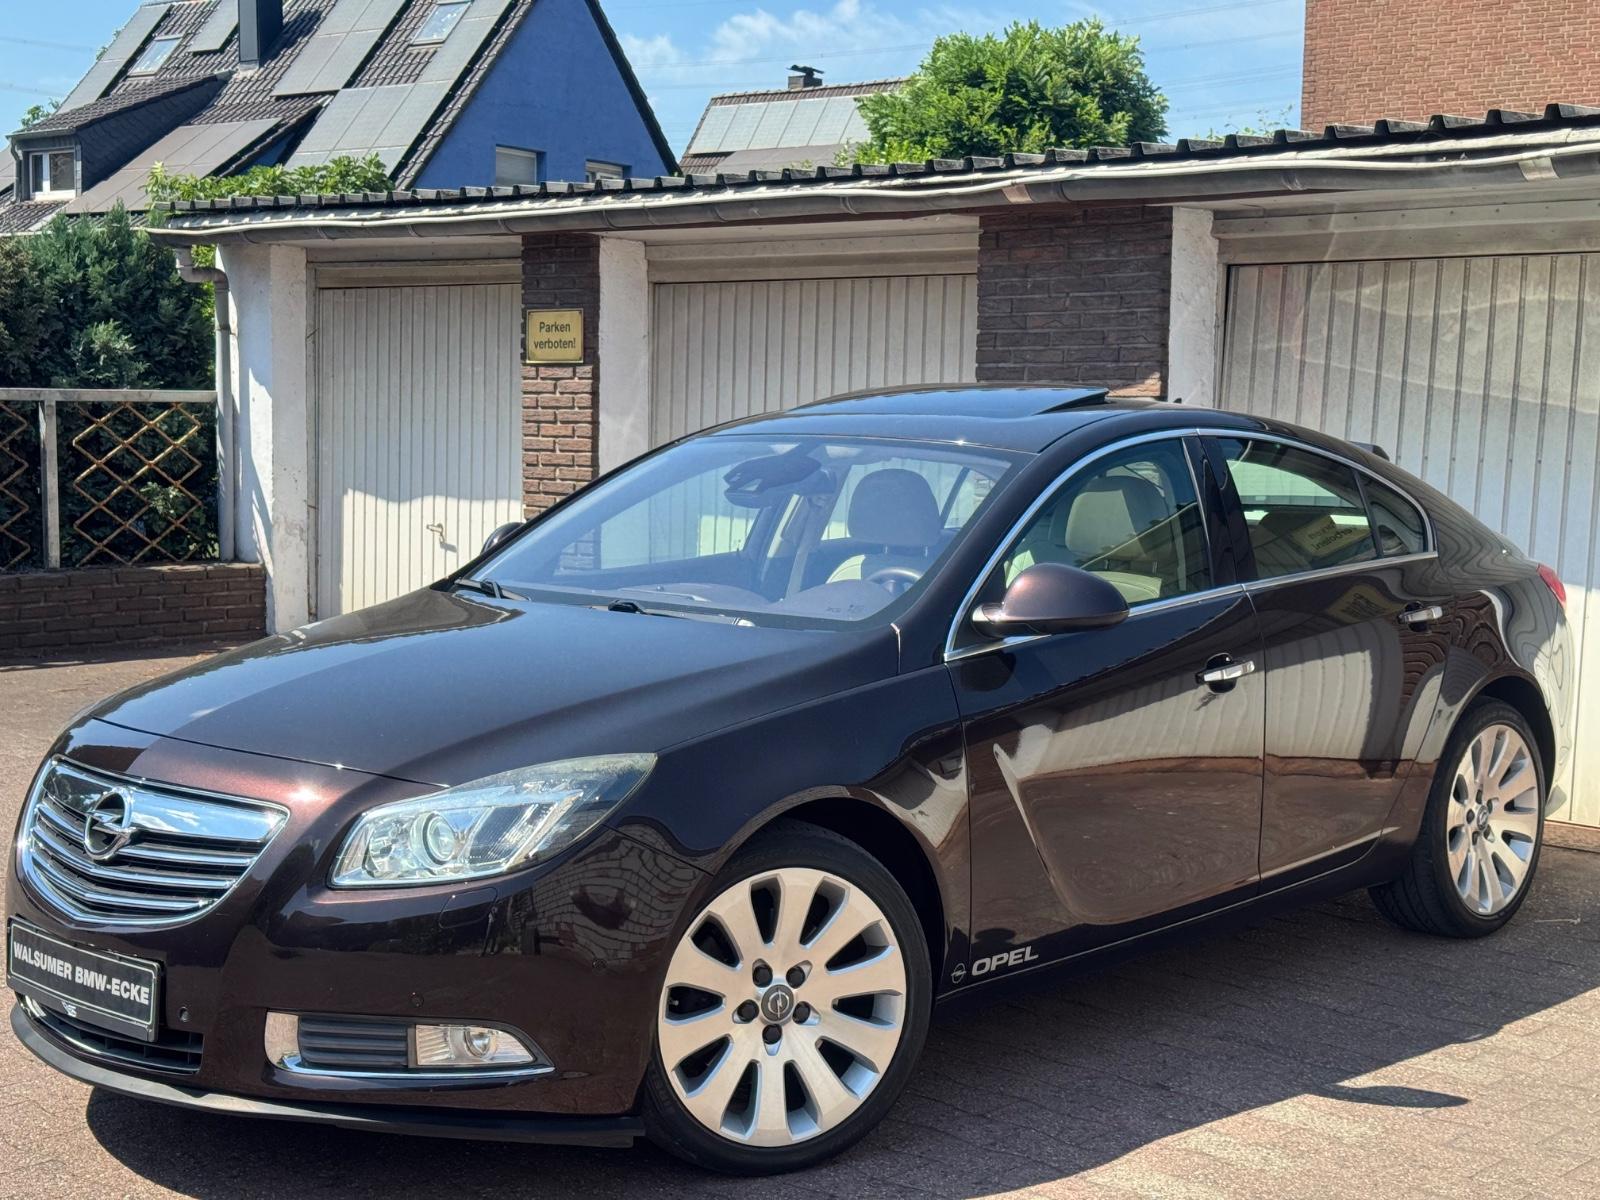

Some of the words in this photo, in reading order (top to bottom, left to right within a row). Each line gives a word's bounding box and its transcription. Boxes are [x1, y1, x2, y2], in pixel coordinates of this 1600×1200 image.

[539, 321, 571, 333] Parken
[533, 337, 576, 349] verboten!
[971, 945, 1039, 977] OPEL
[13, 941, 72, 981] WALSUMER
[74, 965, 150, 1005] BMW-ECKE
